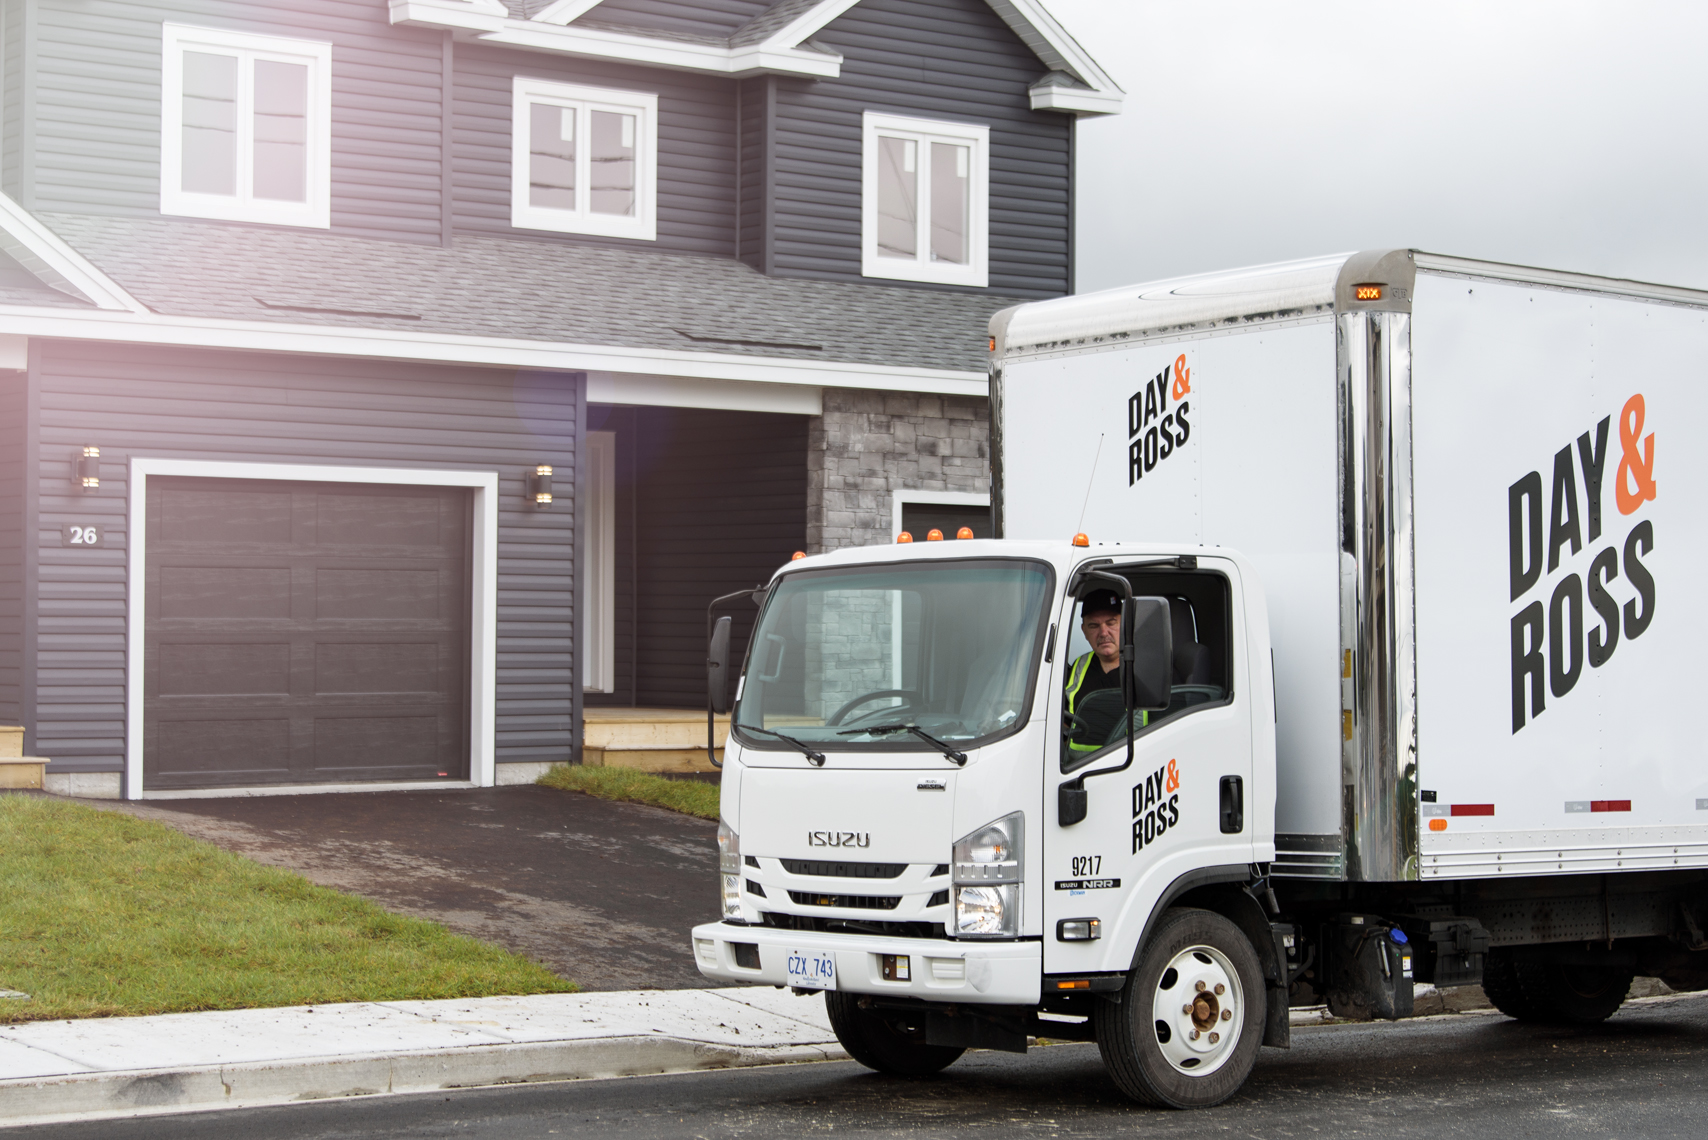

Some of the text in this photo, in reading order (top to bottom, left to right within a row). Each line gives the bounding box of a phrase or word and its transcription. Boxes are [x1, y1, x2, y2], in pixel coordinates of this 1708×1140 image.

[1129, 401, 1190, 488] ROSS
[70, 525, 97, 545] 26
[1510, 520, 1656, 736] ROSS
[1132, 793, 1179, 856] ROSS
[808, 830, 870, 848] ISUZU
[1072, 855, 1102, 877] 9217
[1082, 879, 1114, 889] NRR
[788, 956, 833, 978] CZX 743
